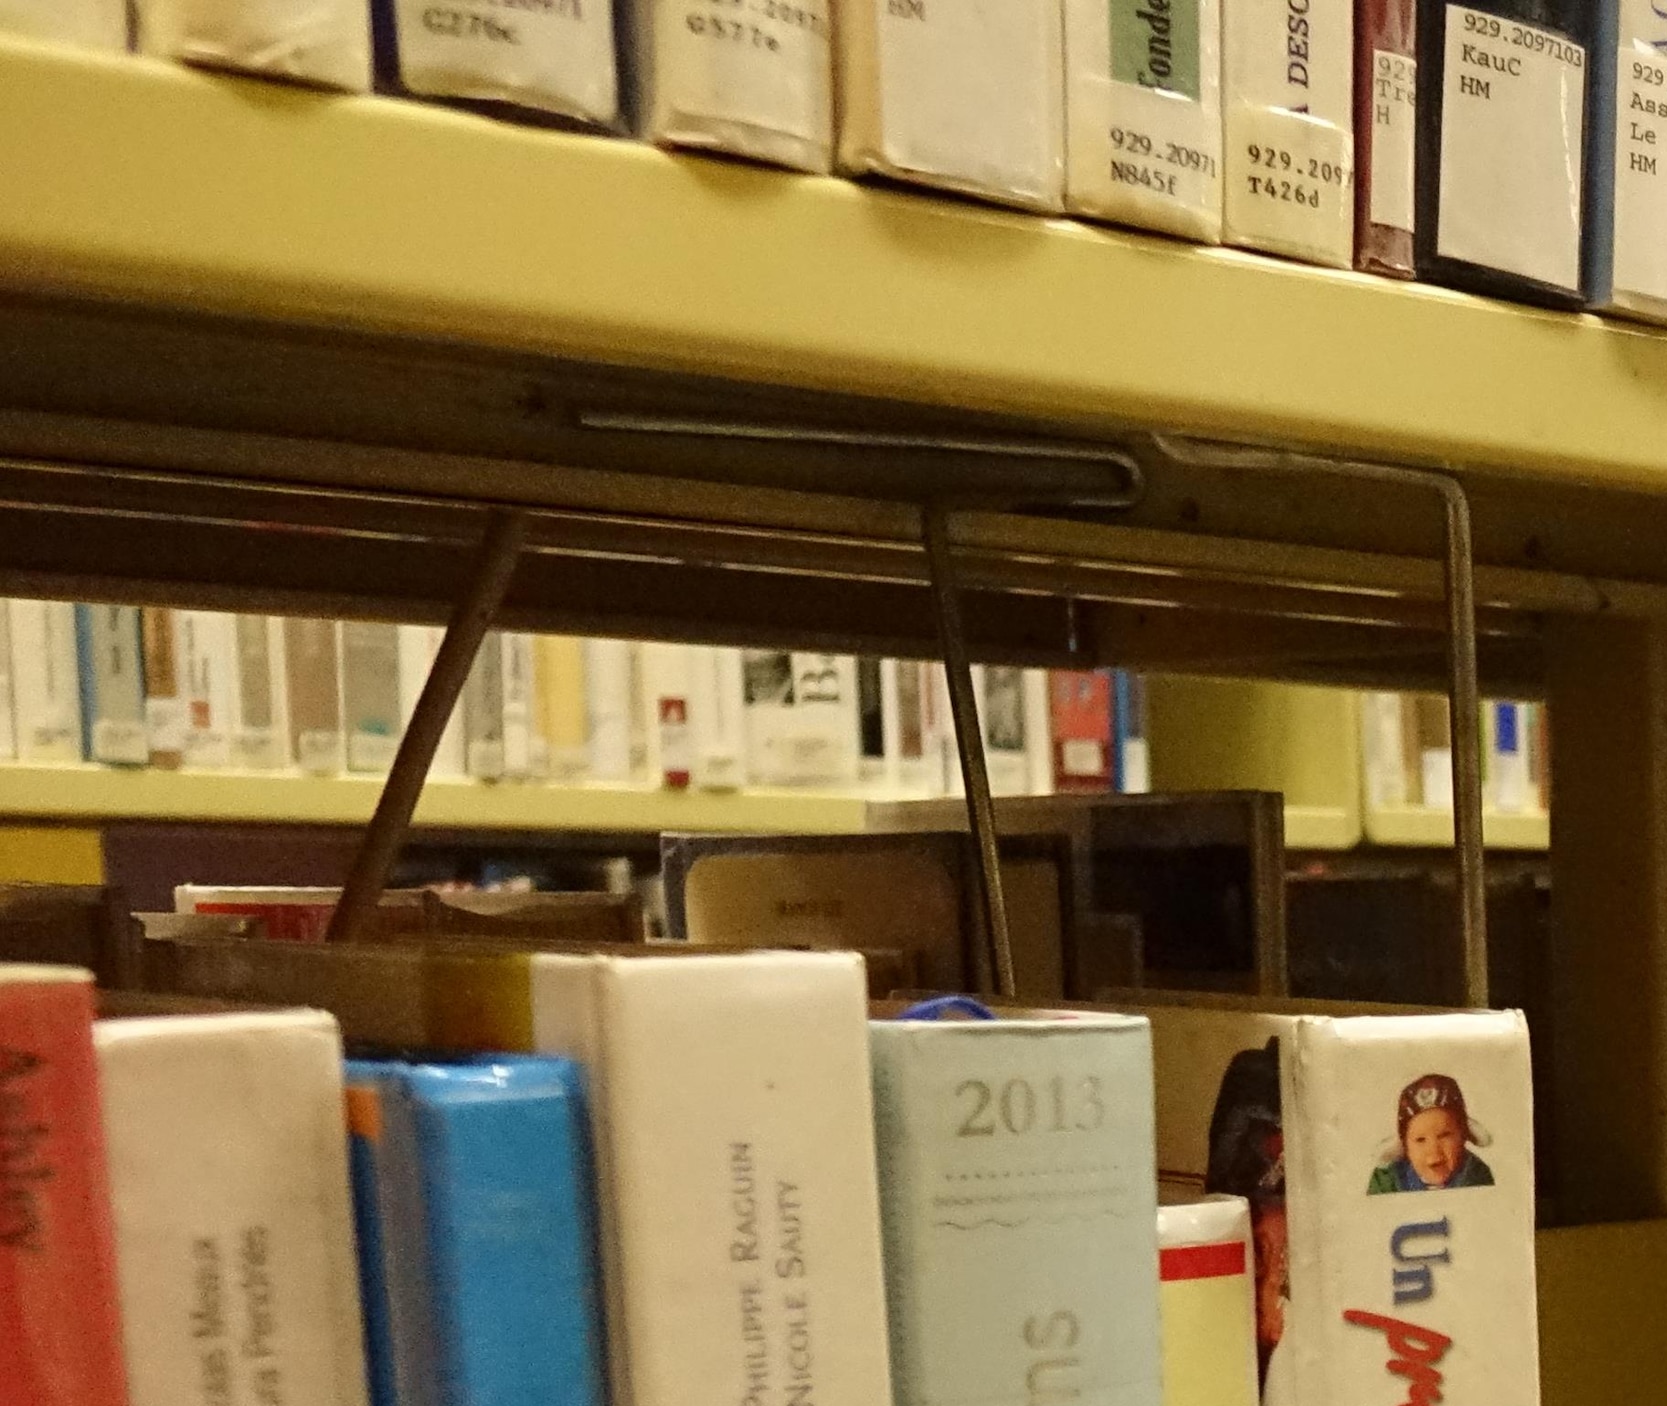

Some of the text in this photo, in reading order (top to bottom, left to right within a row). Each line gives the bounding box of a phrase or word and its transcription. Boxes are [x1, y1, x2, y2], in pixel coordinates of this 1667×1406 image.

[1461, 43, 1522, 77] KauC
[1463, 13, 1583, 68] 929.2097103
[1460, 75, 1491, 100] HM
[1630, 123, 1657, 145] Le
[1248, 144, 1354, 188] 929.209
[1629, 154, 1658, 176] HM
[952, 1072, 1107, 1140] 2013
[1388, 1216, 1453, 1309] Un
